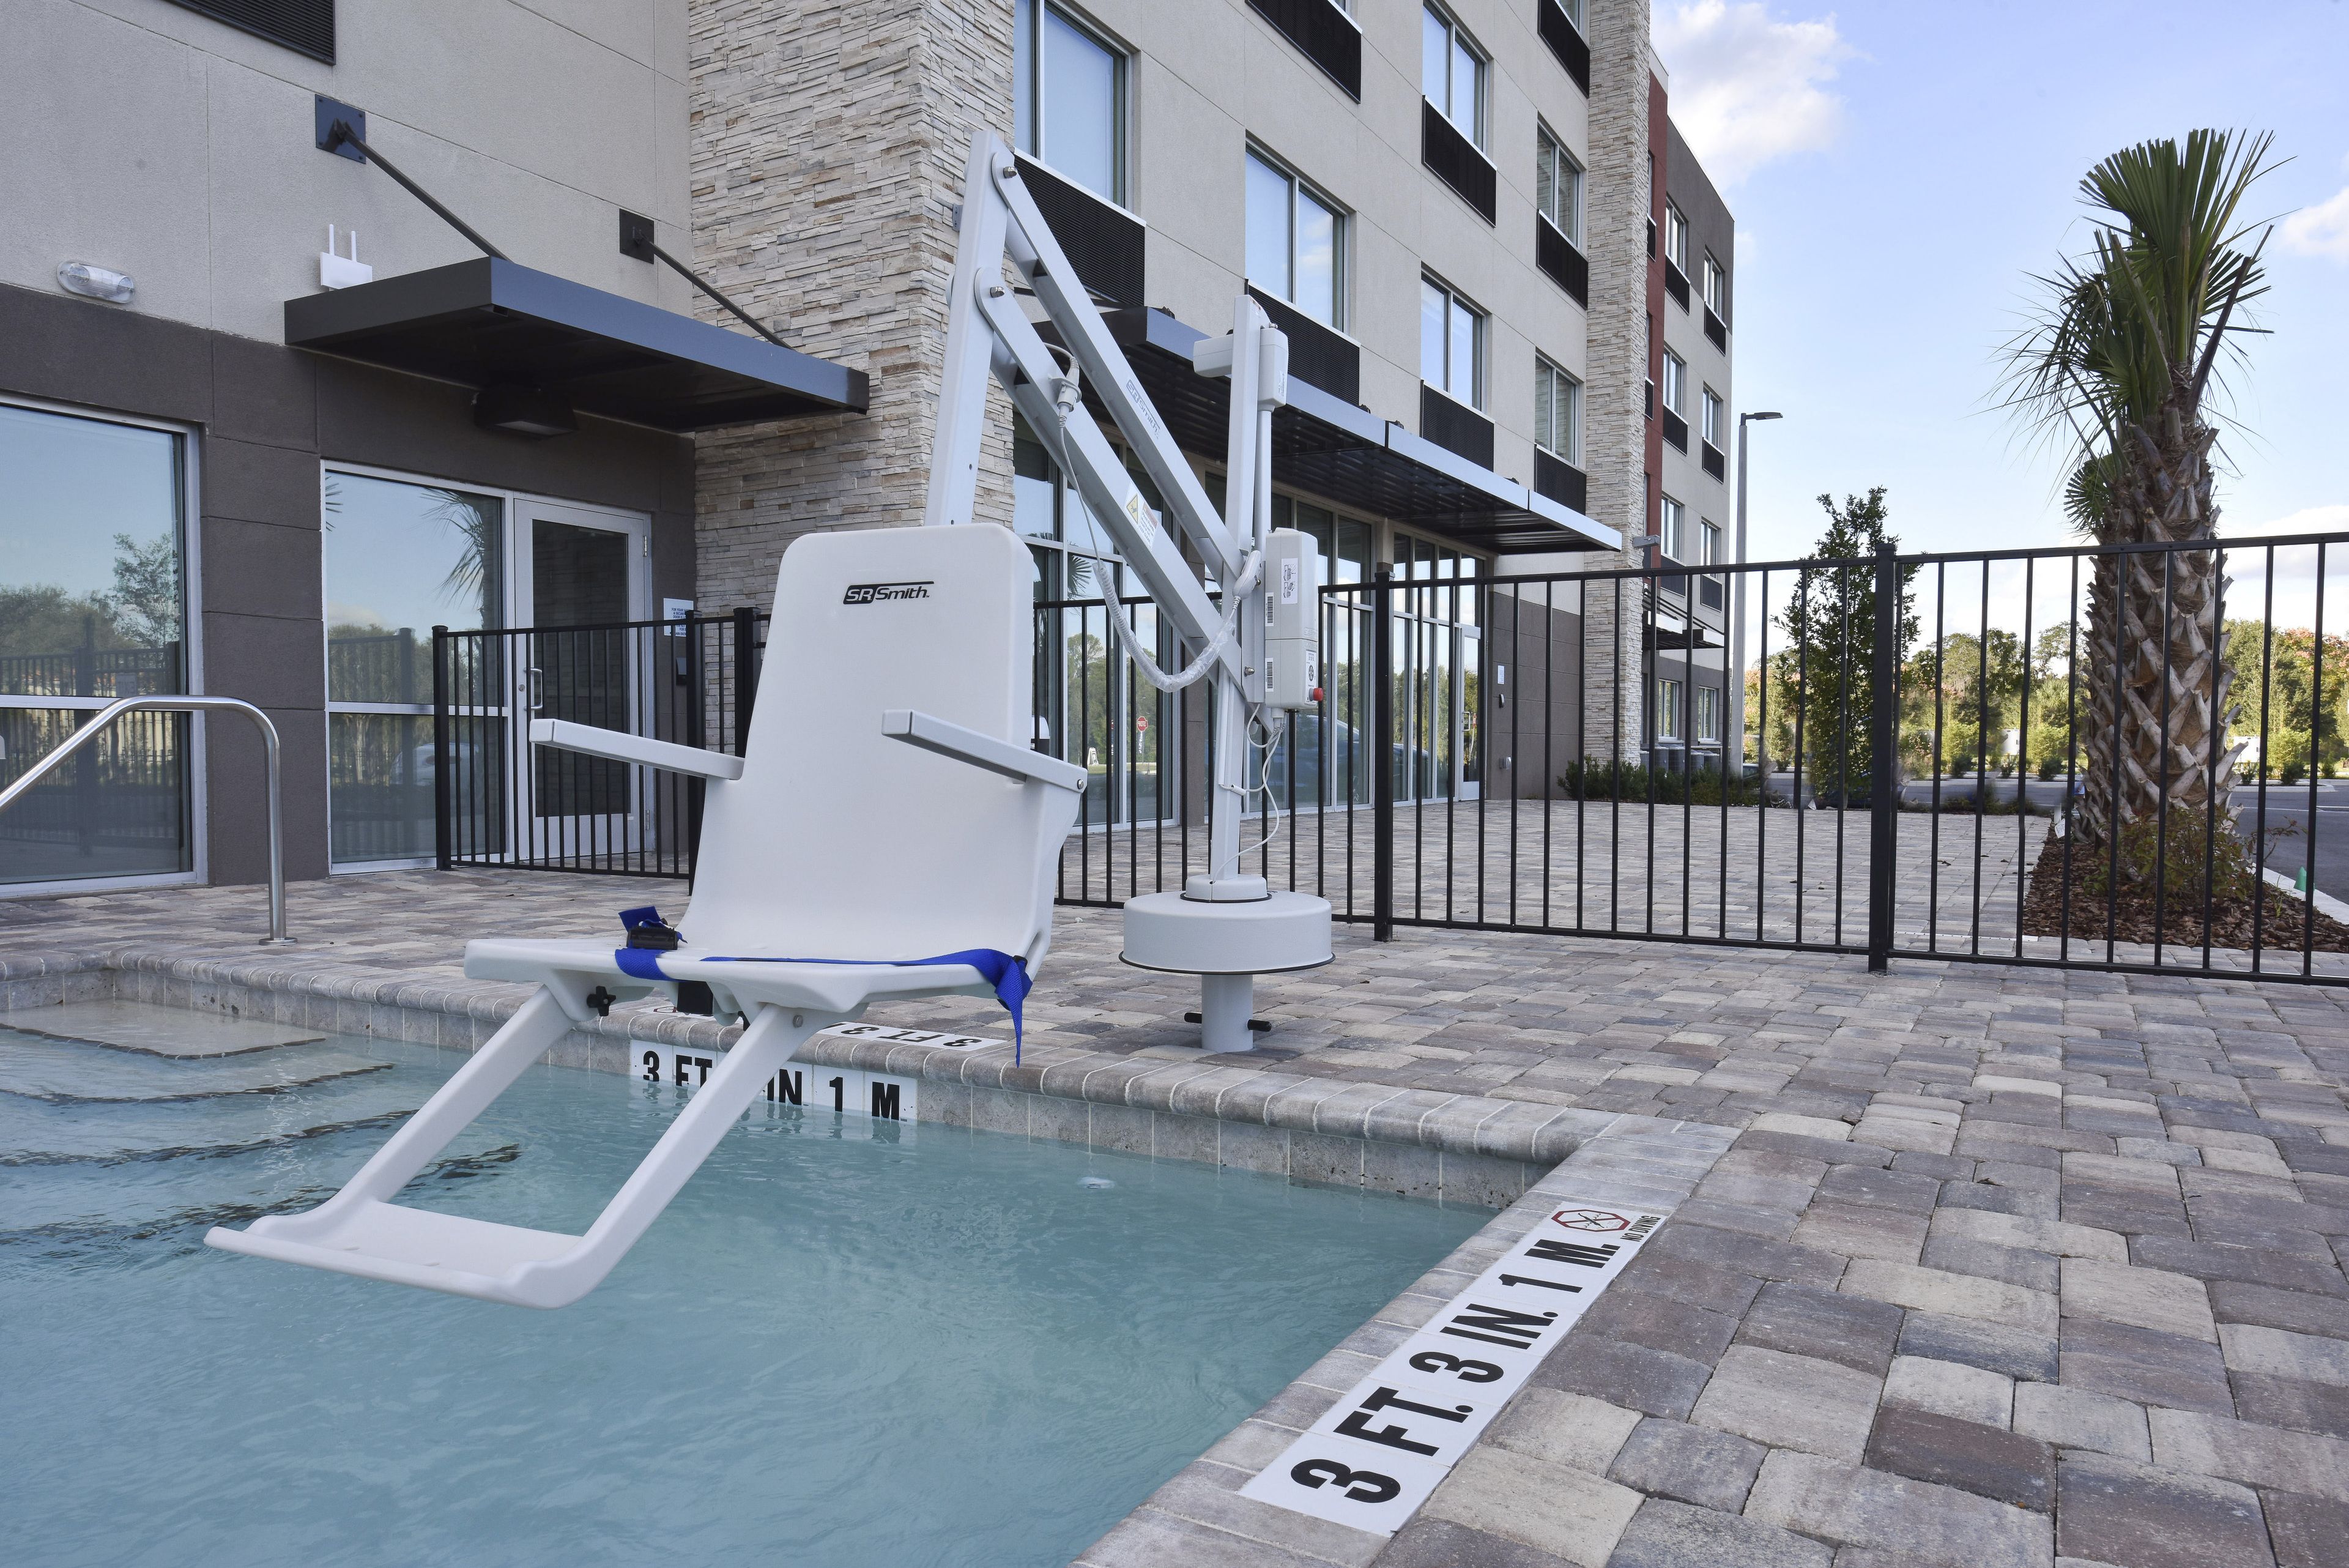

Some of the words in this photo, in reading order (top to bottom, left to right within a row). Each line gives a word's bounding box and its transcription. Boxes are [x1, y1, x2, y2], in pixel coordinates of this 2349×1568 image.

[943, 1038, 982, 1047] 3
[643, 1050, 659, 1082] 3
[829, 1076, 844, 1112] 1
[1620, 1233, 1644, 1242] NO
[1628, 1215, 1661, 1234] DIVING
[1524, 1239, 1620, 1269] M.
[1497, 1273, 1583, 1293] 1
[1439, 1303, 1559, 1350] IN.
[1409, 1351, 1504, 1383] 3
[1333, 1386, 1474, 1457] FT.
[1290, 1458, 1401, 1504] 3
